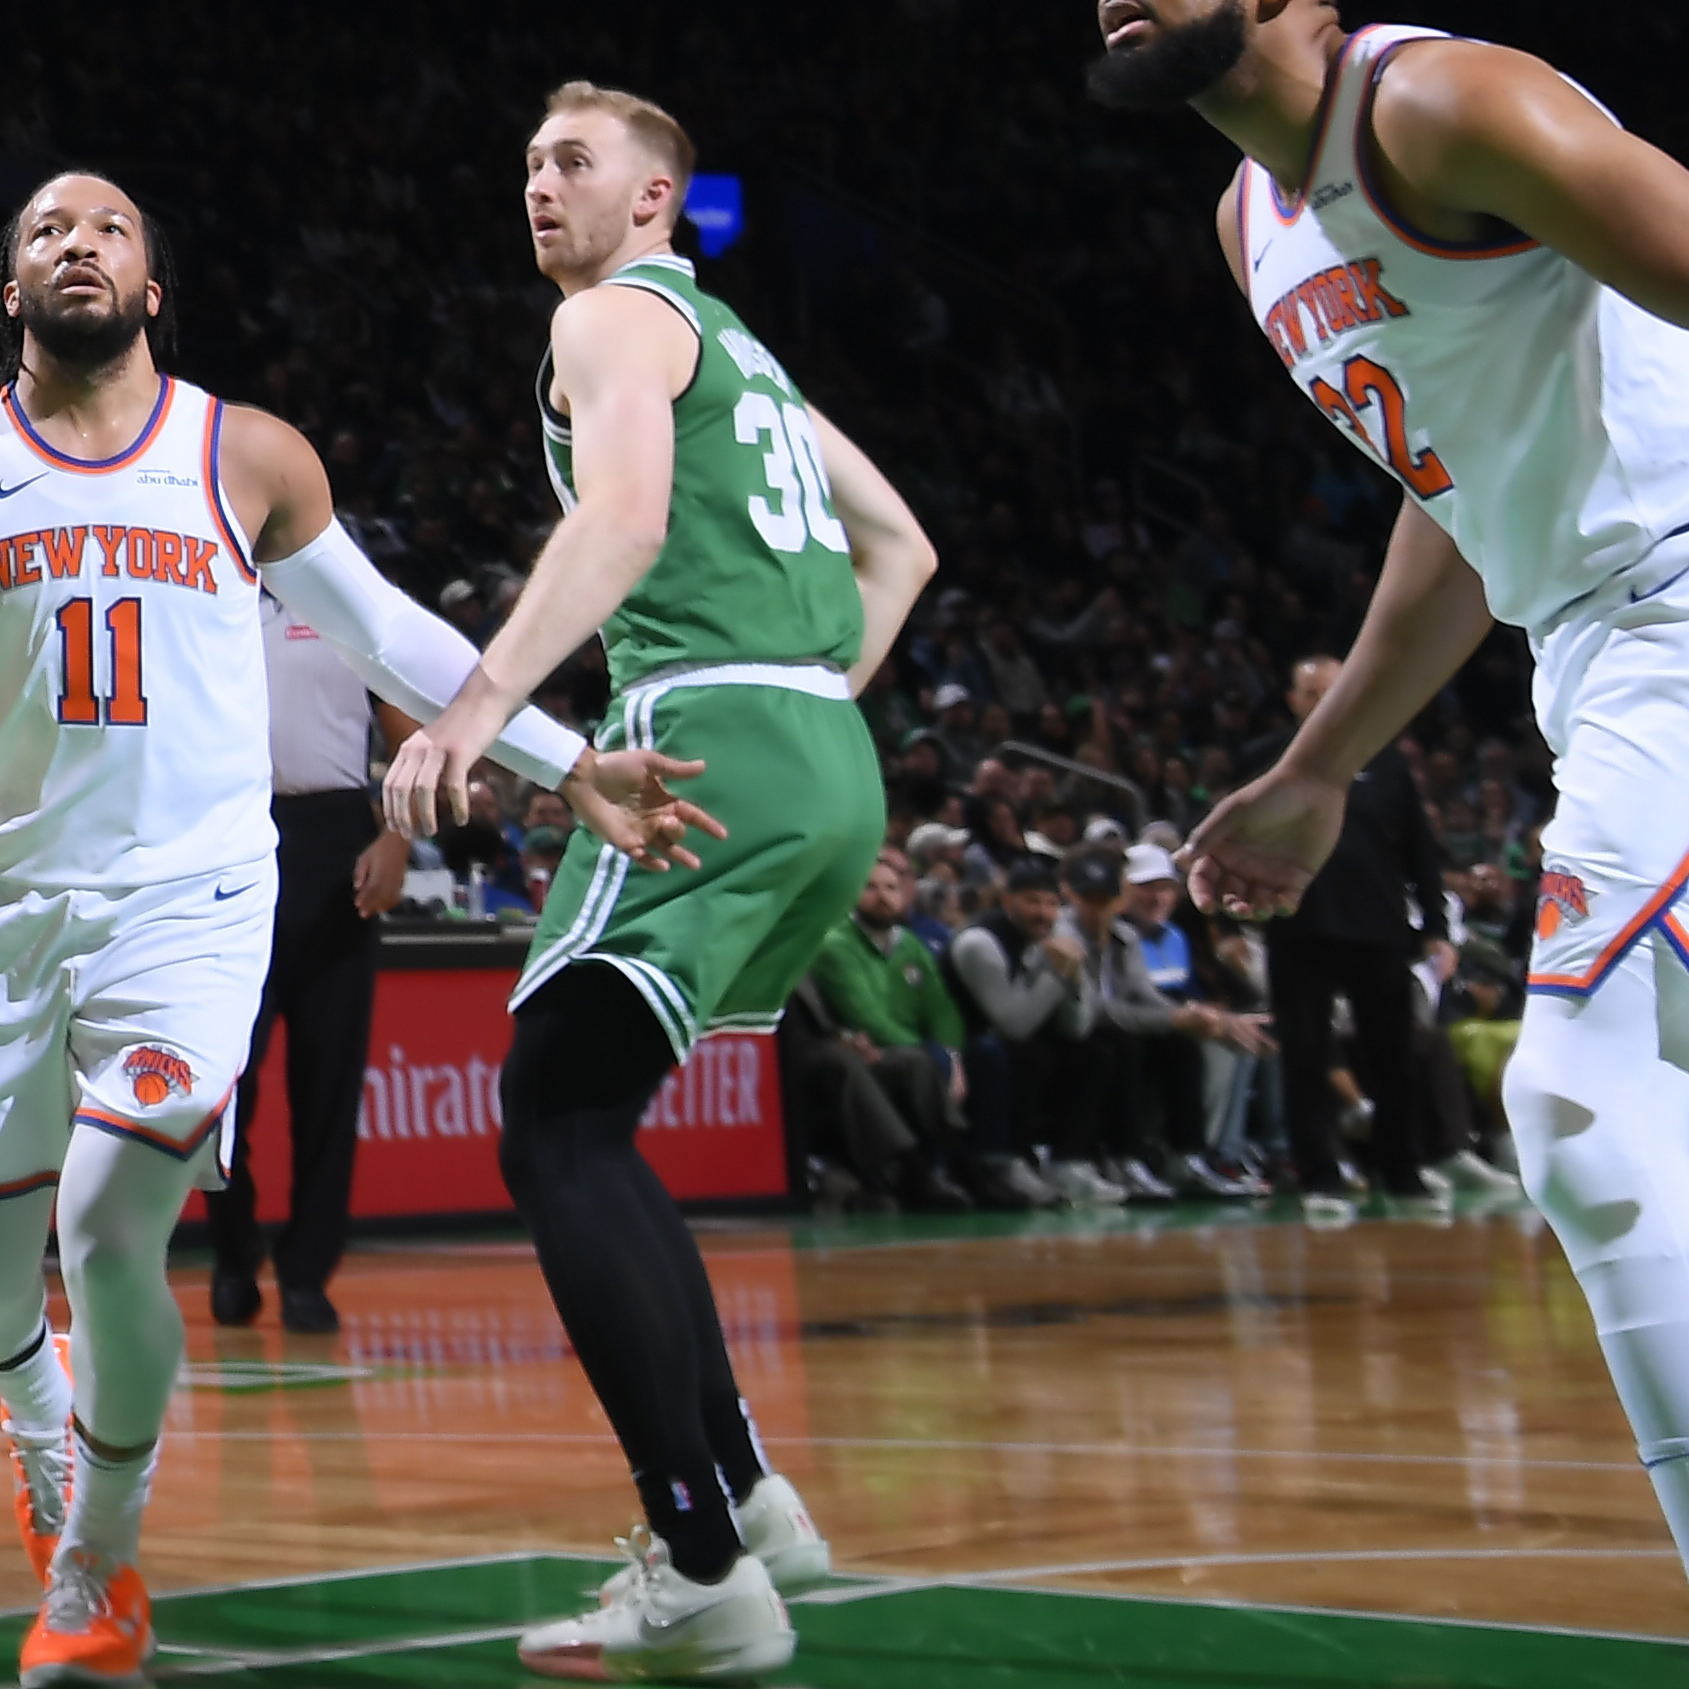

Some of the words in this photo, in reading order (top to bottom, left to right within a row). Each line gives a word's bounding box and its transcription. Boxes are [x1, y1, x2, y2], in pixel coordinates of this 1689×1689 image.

[1298, 258, 1410, 342] YORK
[733, 391, 850, 553] 30
[93, 525, 219, 596] YORK
[56, 597, 150, 727] 11
